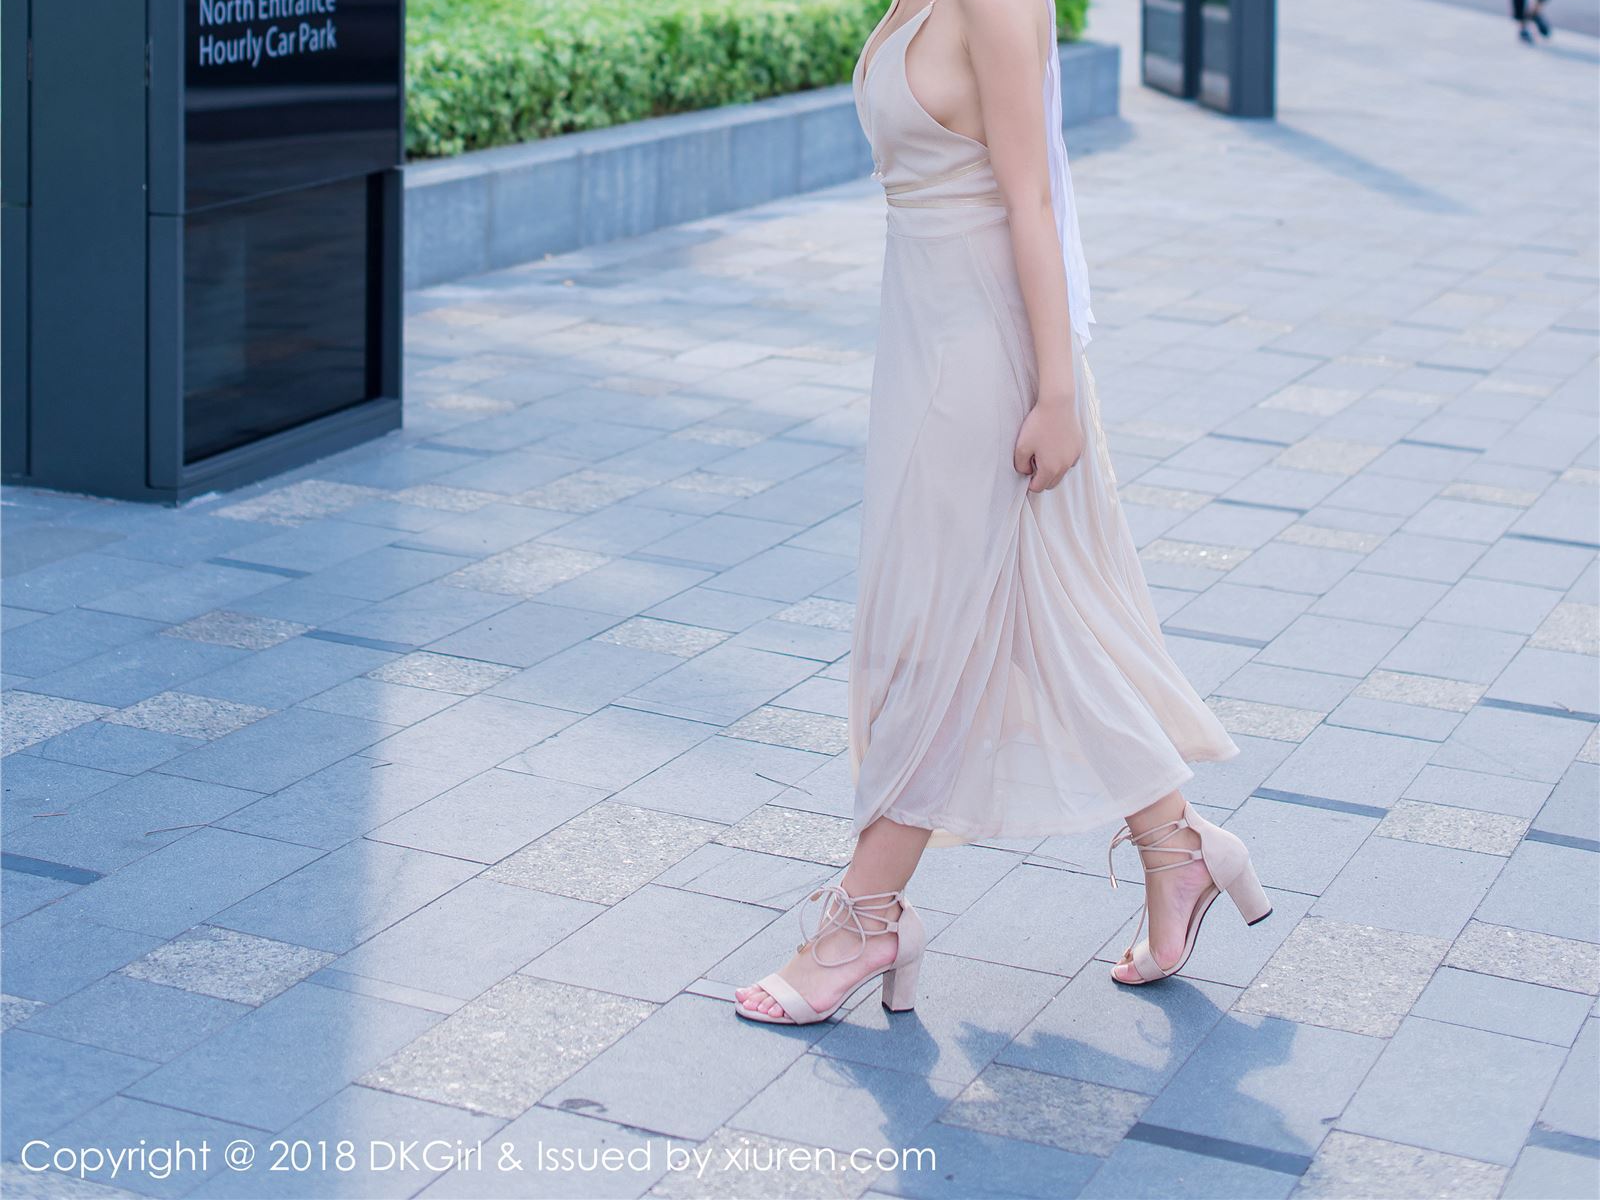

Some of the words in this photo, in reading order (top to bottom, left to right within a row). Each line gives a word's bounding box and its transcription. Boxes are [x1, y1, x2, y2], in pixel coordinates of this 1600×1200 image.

[199, 28, 263, 68] Hourly
[265, 25, 296, 58] Car
[299, 18, 337, 52] Park
